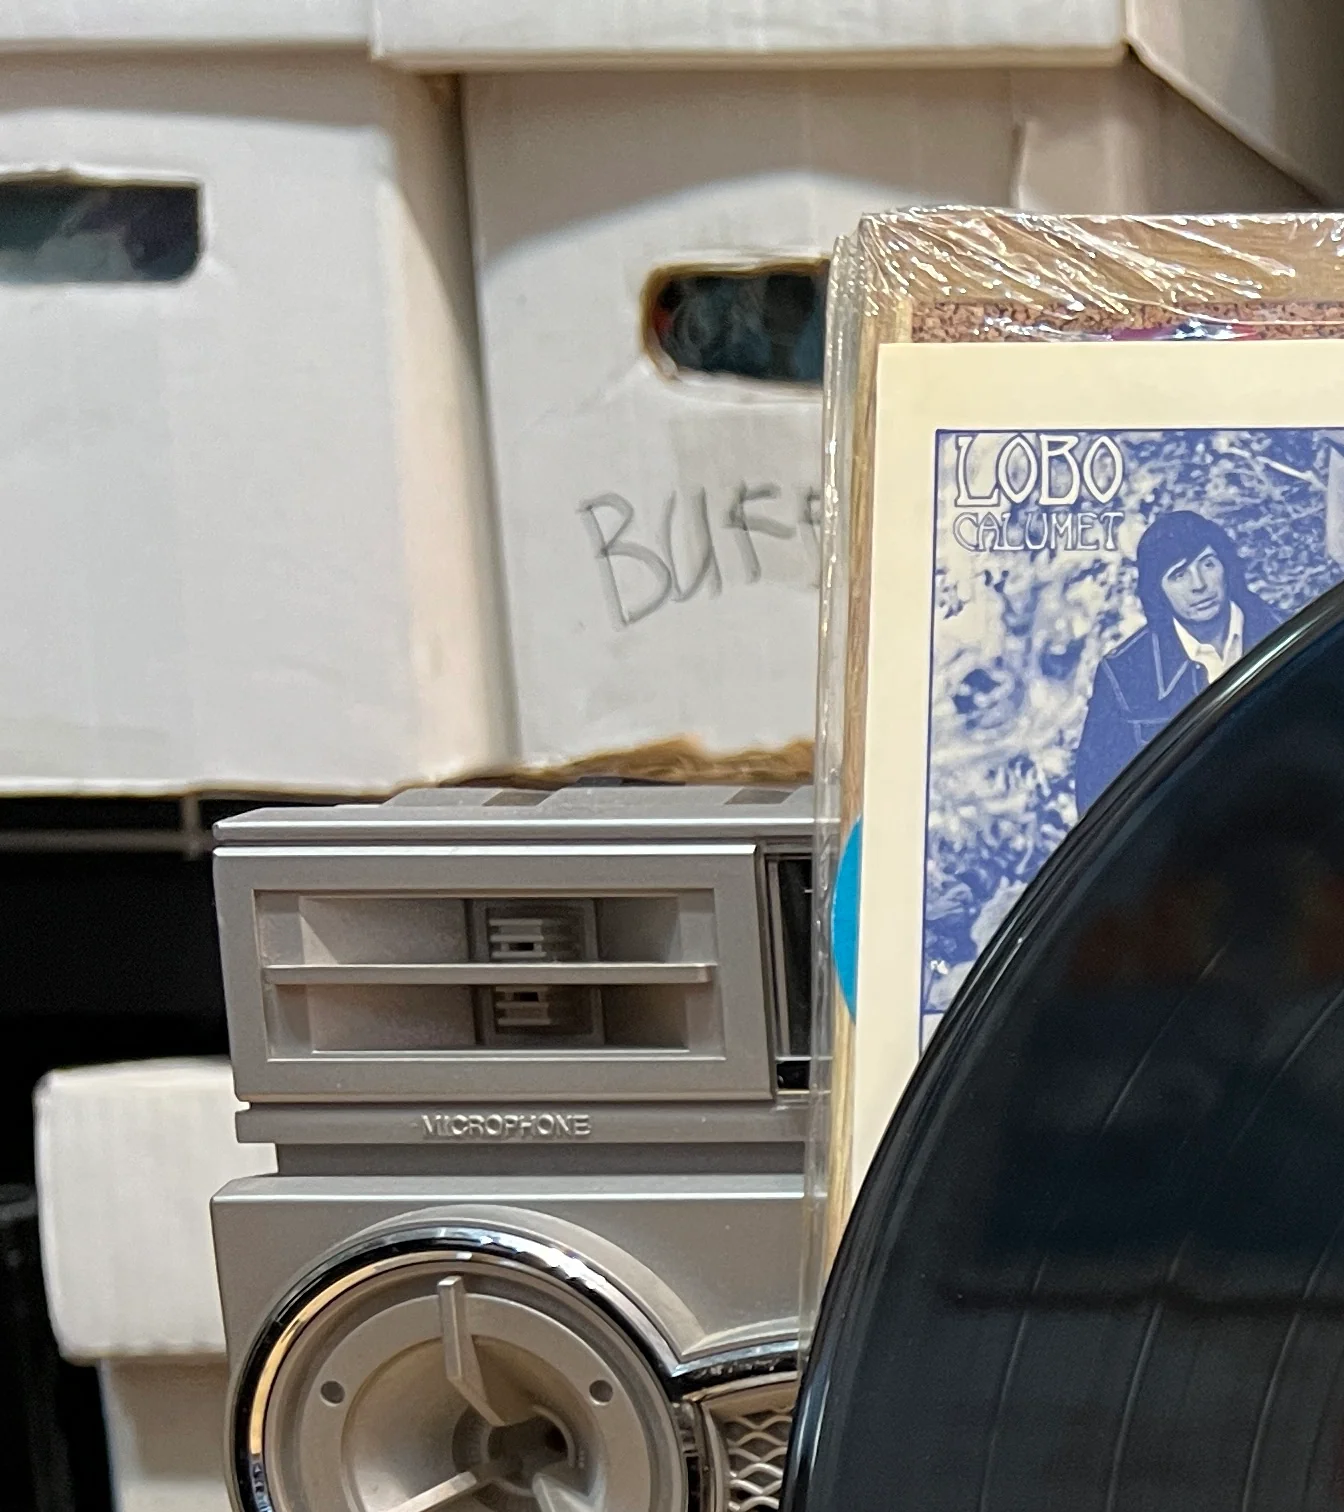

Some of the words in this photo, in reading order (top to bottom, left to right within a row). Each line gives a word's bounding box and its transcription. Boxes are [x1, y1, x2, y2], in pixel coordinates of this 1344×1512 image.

[955, 433, 1125, 507] LOBO
[953, 511, 1124, 551] CALUMET
[421, 1113, 592, 1140] MICROPHONE
